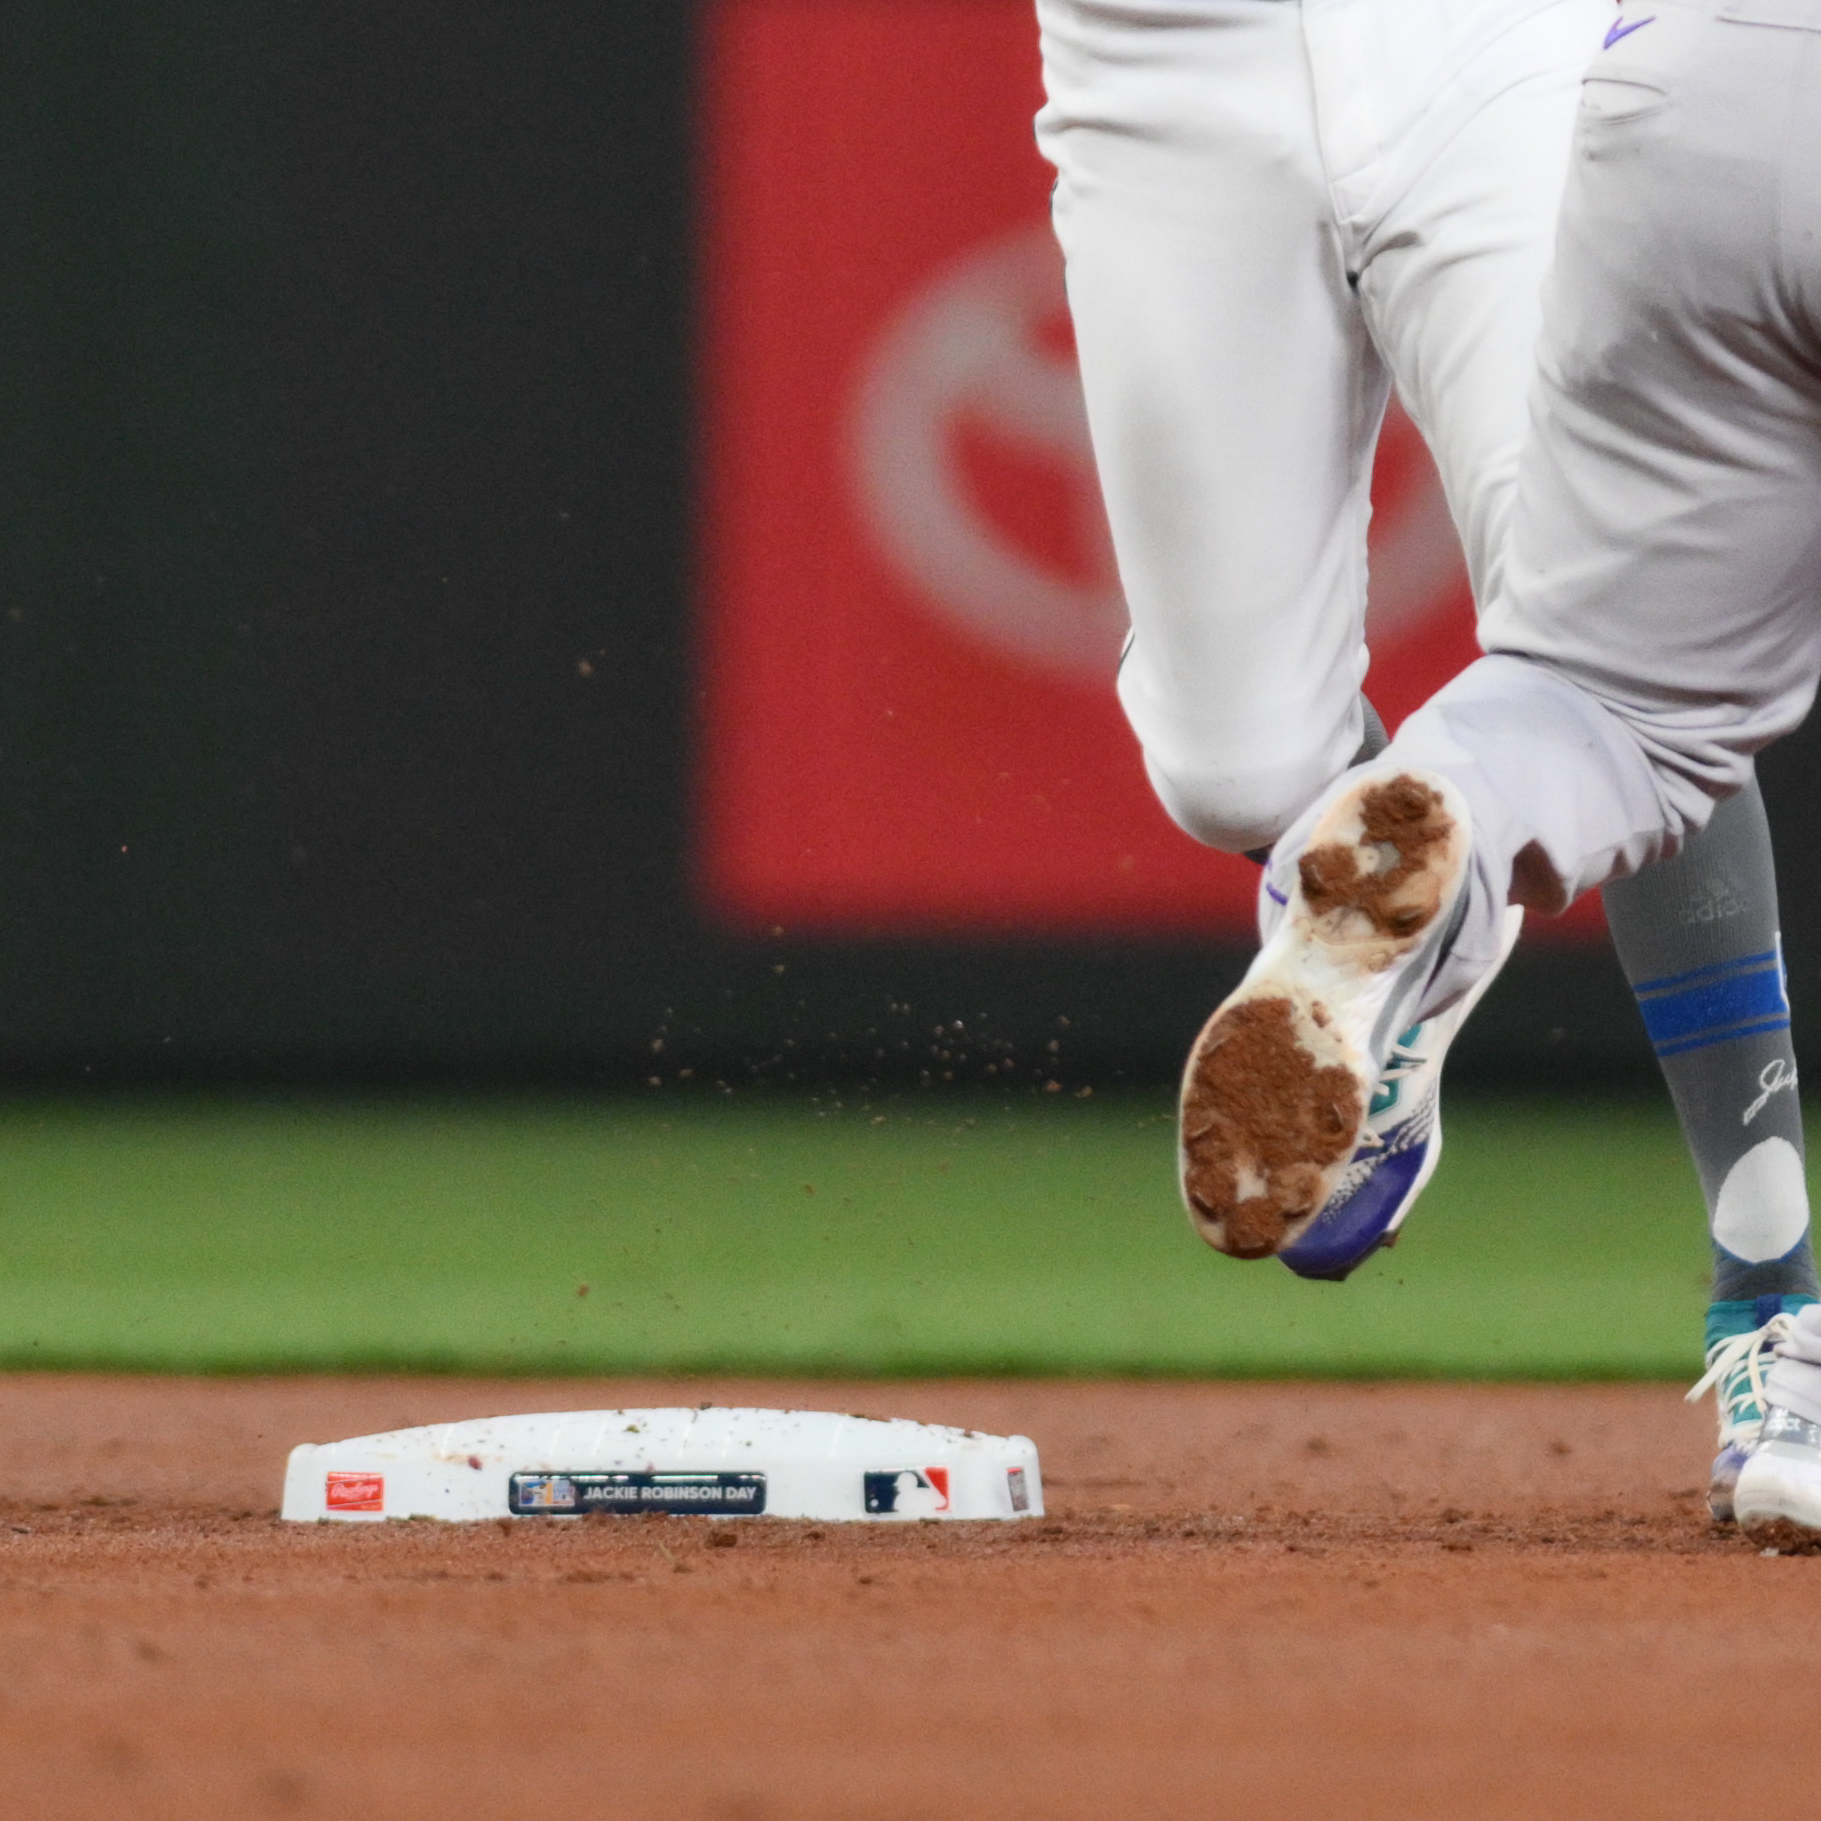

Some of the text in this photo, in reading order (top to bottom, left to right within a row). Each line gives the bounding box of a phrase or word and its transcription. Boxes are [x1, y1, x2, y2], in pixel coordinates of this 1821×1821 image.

[583, 1486, 758, 1500] JACKIE ROBINSON DAY
